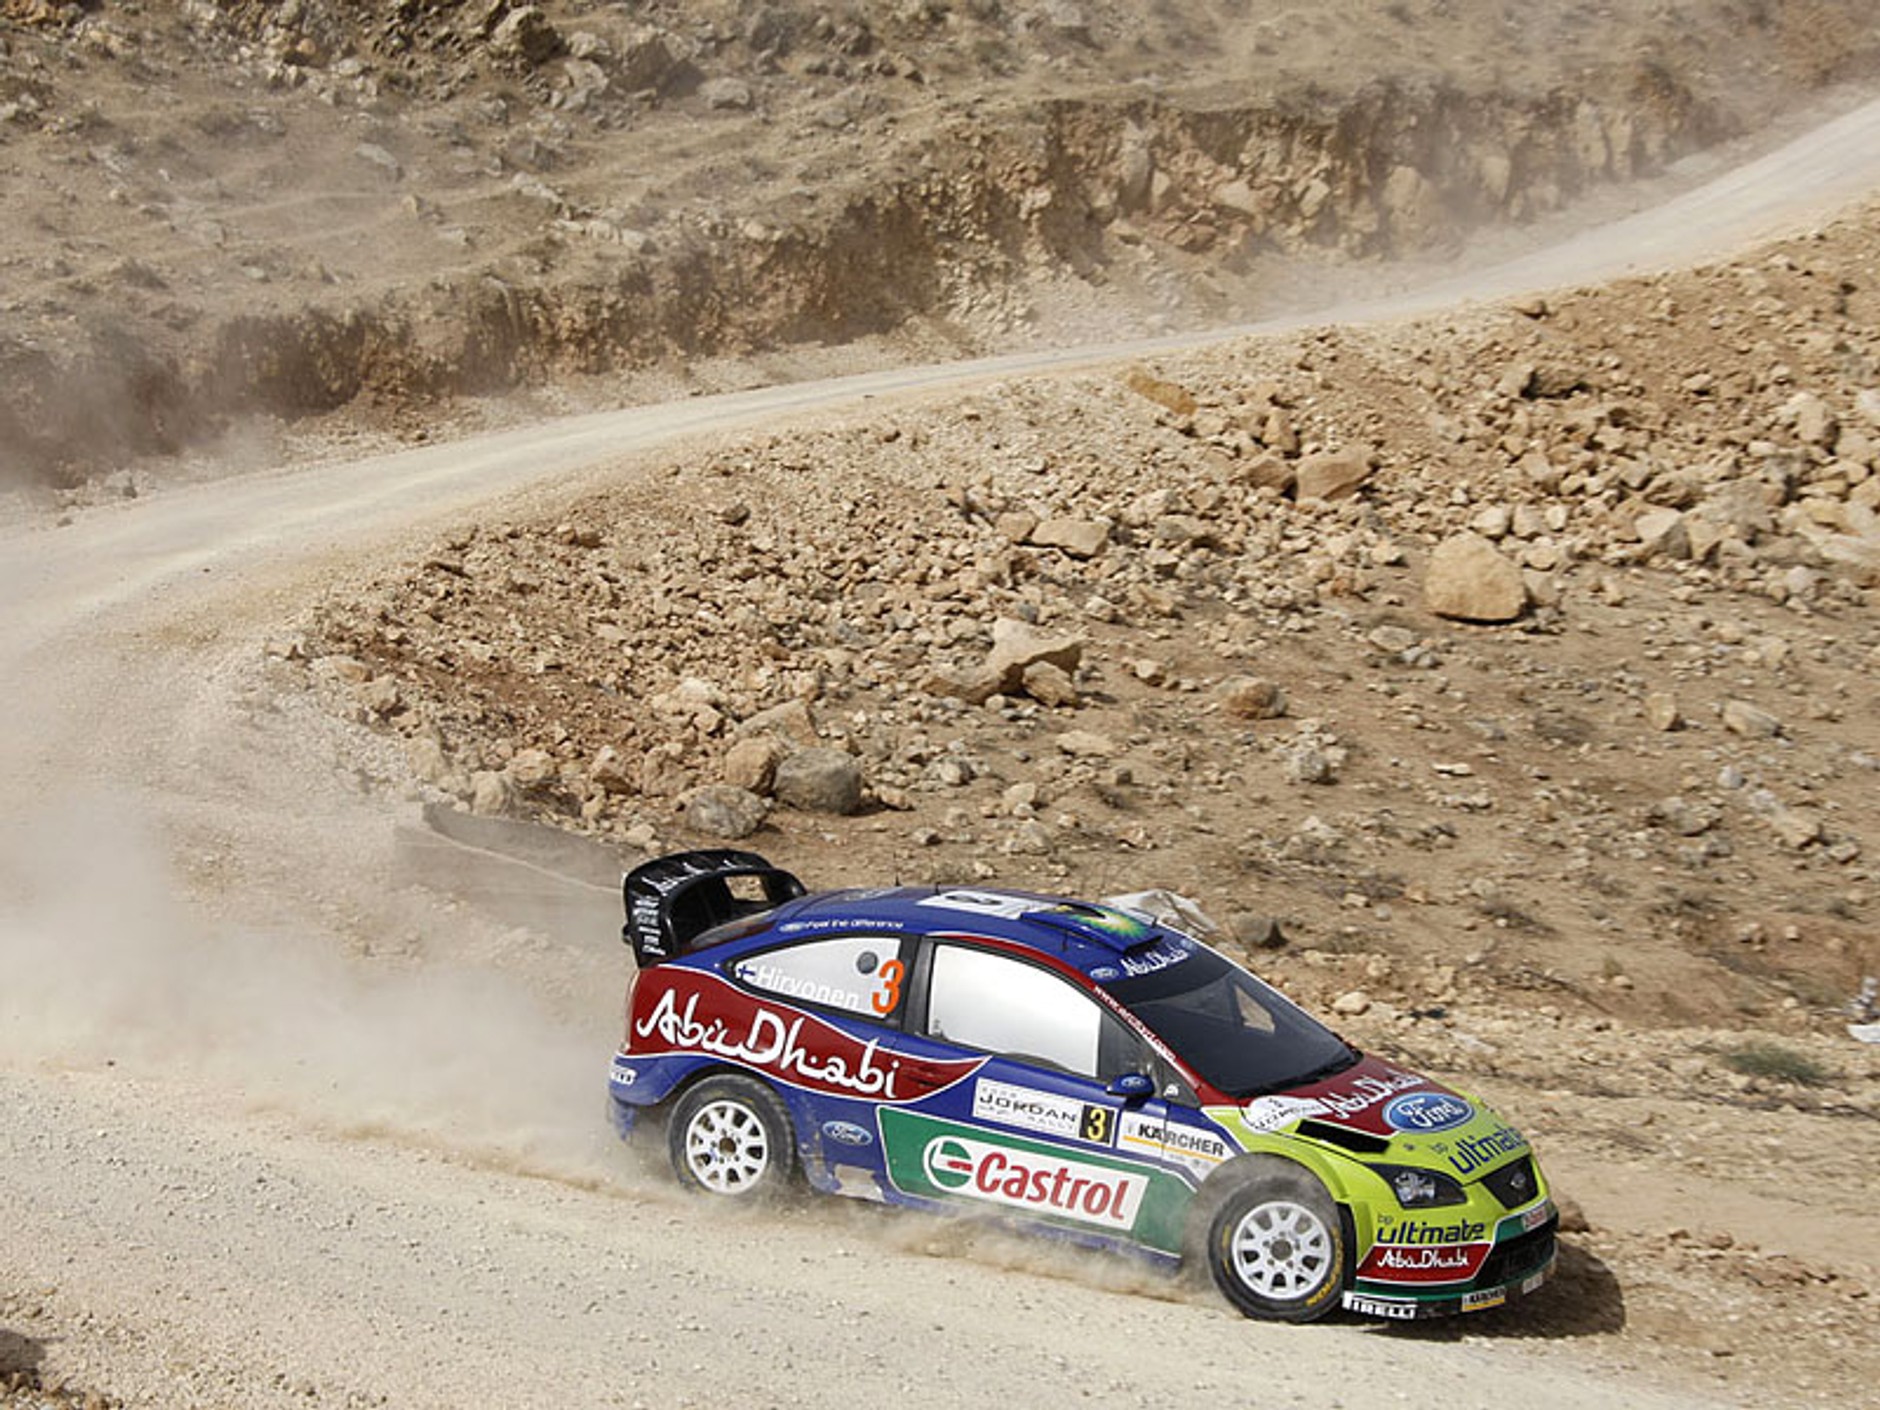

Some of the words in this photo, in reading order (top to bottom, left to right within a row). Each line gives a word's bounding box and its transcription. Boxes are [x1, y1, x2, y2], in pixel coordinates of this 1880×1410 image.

[755, 963, 860, 1010] Hirvonen
[872, 960, 905, 1014] 3
[745, 1008, 899, 1098] Dhabi
[979, 1092, 1077, 1123] JORDAN
[1396, 1097, 1465, 1128] Ford
[828, 1125, 865, 1144] Ford
[1086, 1108, 1107, 1141] 3
[976, 1151, 1130, 1220] Castrol
[1376, 1218, 1485, 1244] ultimate
[1342, 1289, 1418, 1320] PIRELLI
